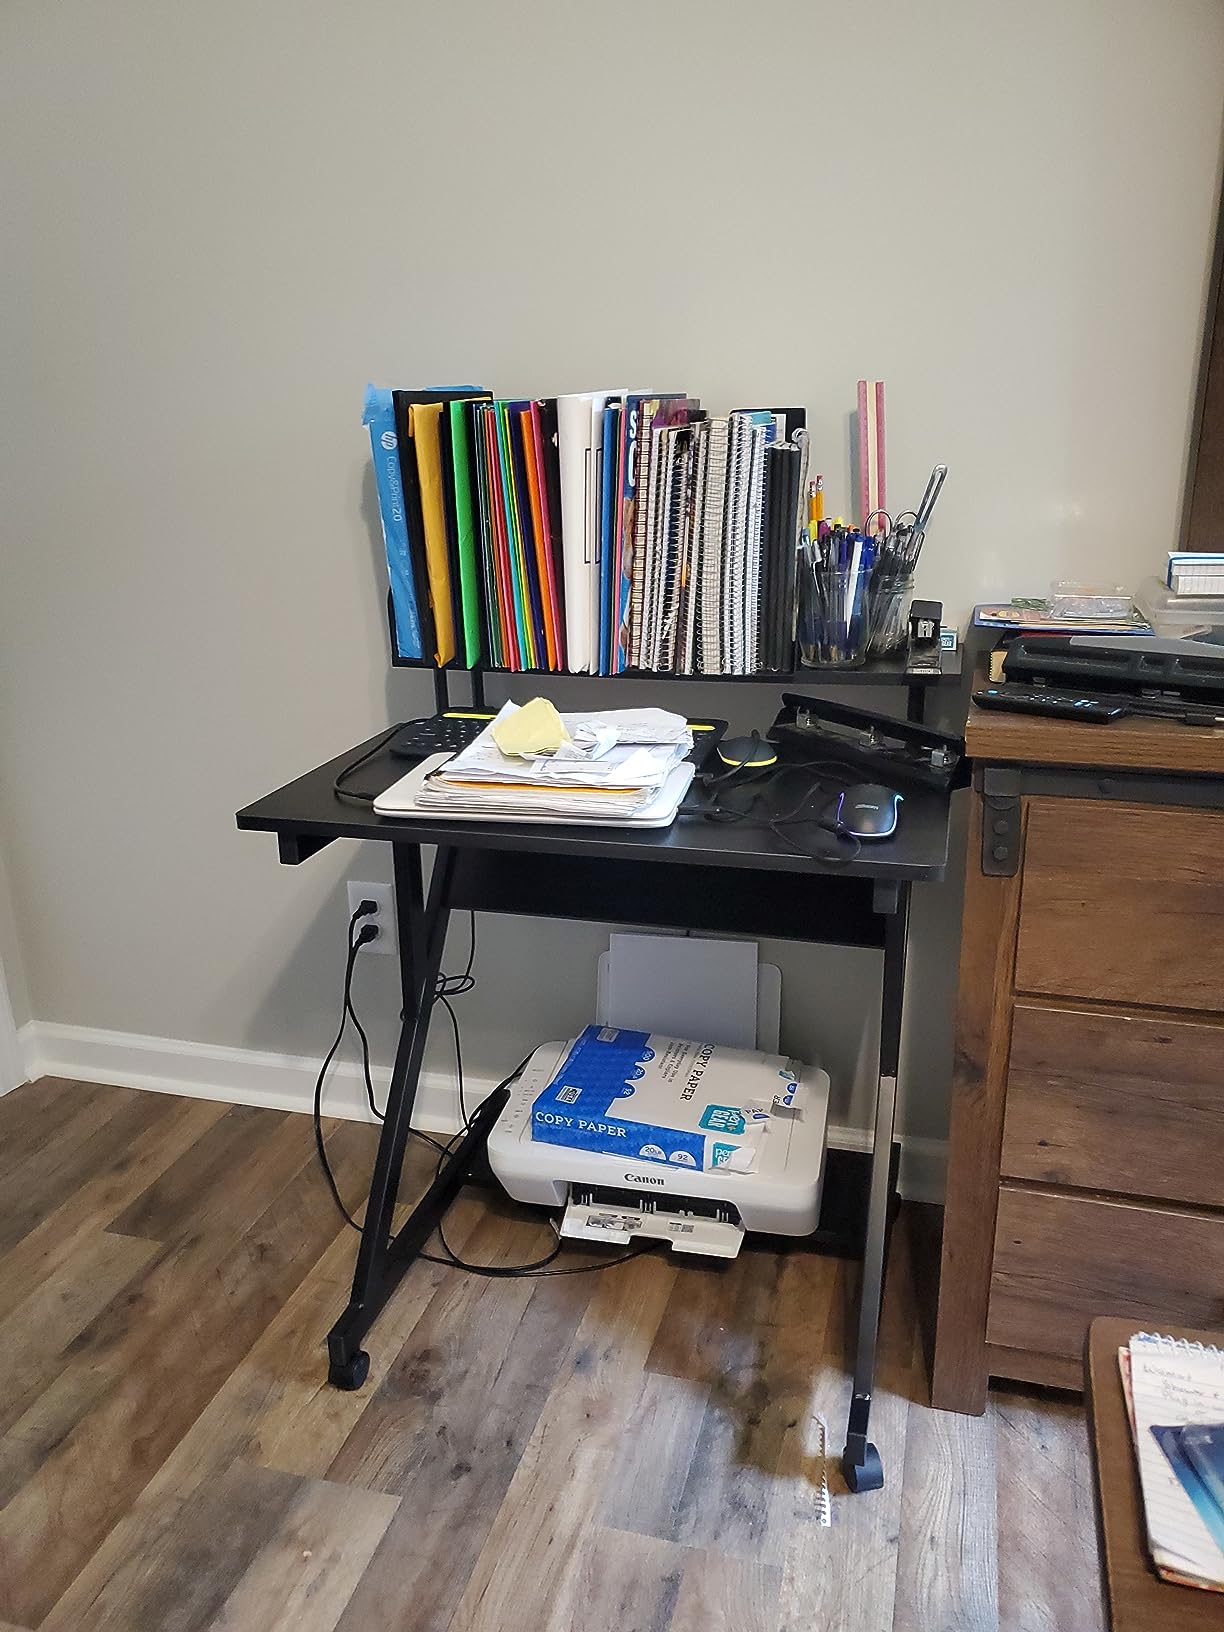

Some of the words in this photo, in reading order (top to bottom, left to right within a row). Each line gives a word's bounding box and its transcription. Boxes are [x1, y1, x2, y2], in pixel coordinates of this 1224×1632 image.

[695, 1043, 716, 1068] COPY
[679, 1069, 704, 1101] PAPER
[535, 1110, 574, 1127] COPY
[578, 1119, 628, 1138] PAPER
[677, 1153, 689, 1161] 92
[624, 1173, 666, 1186] Canon
